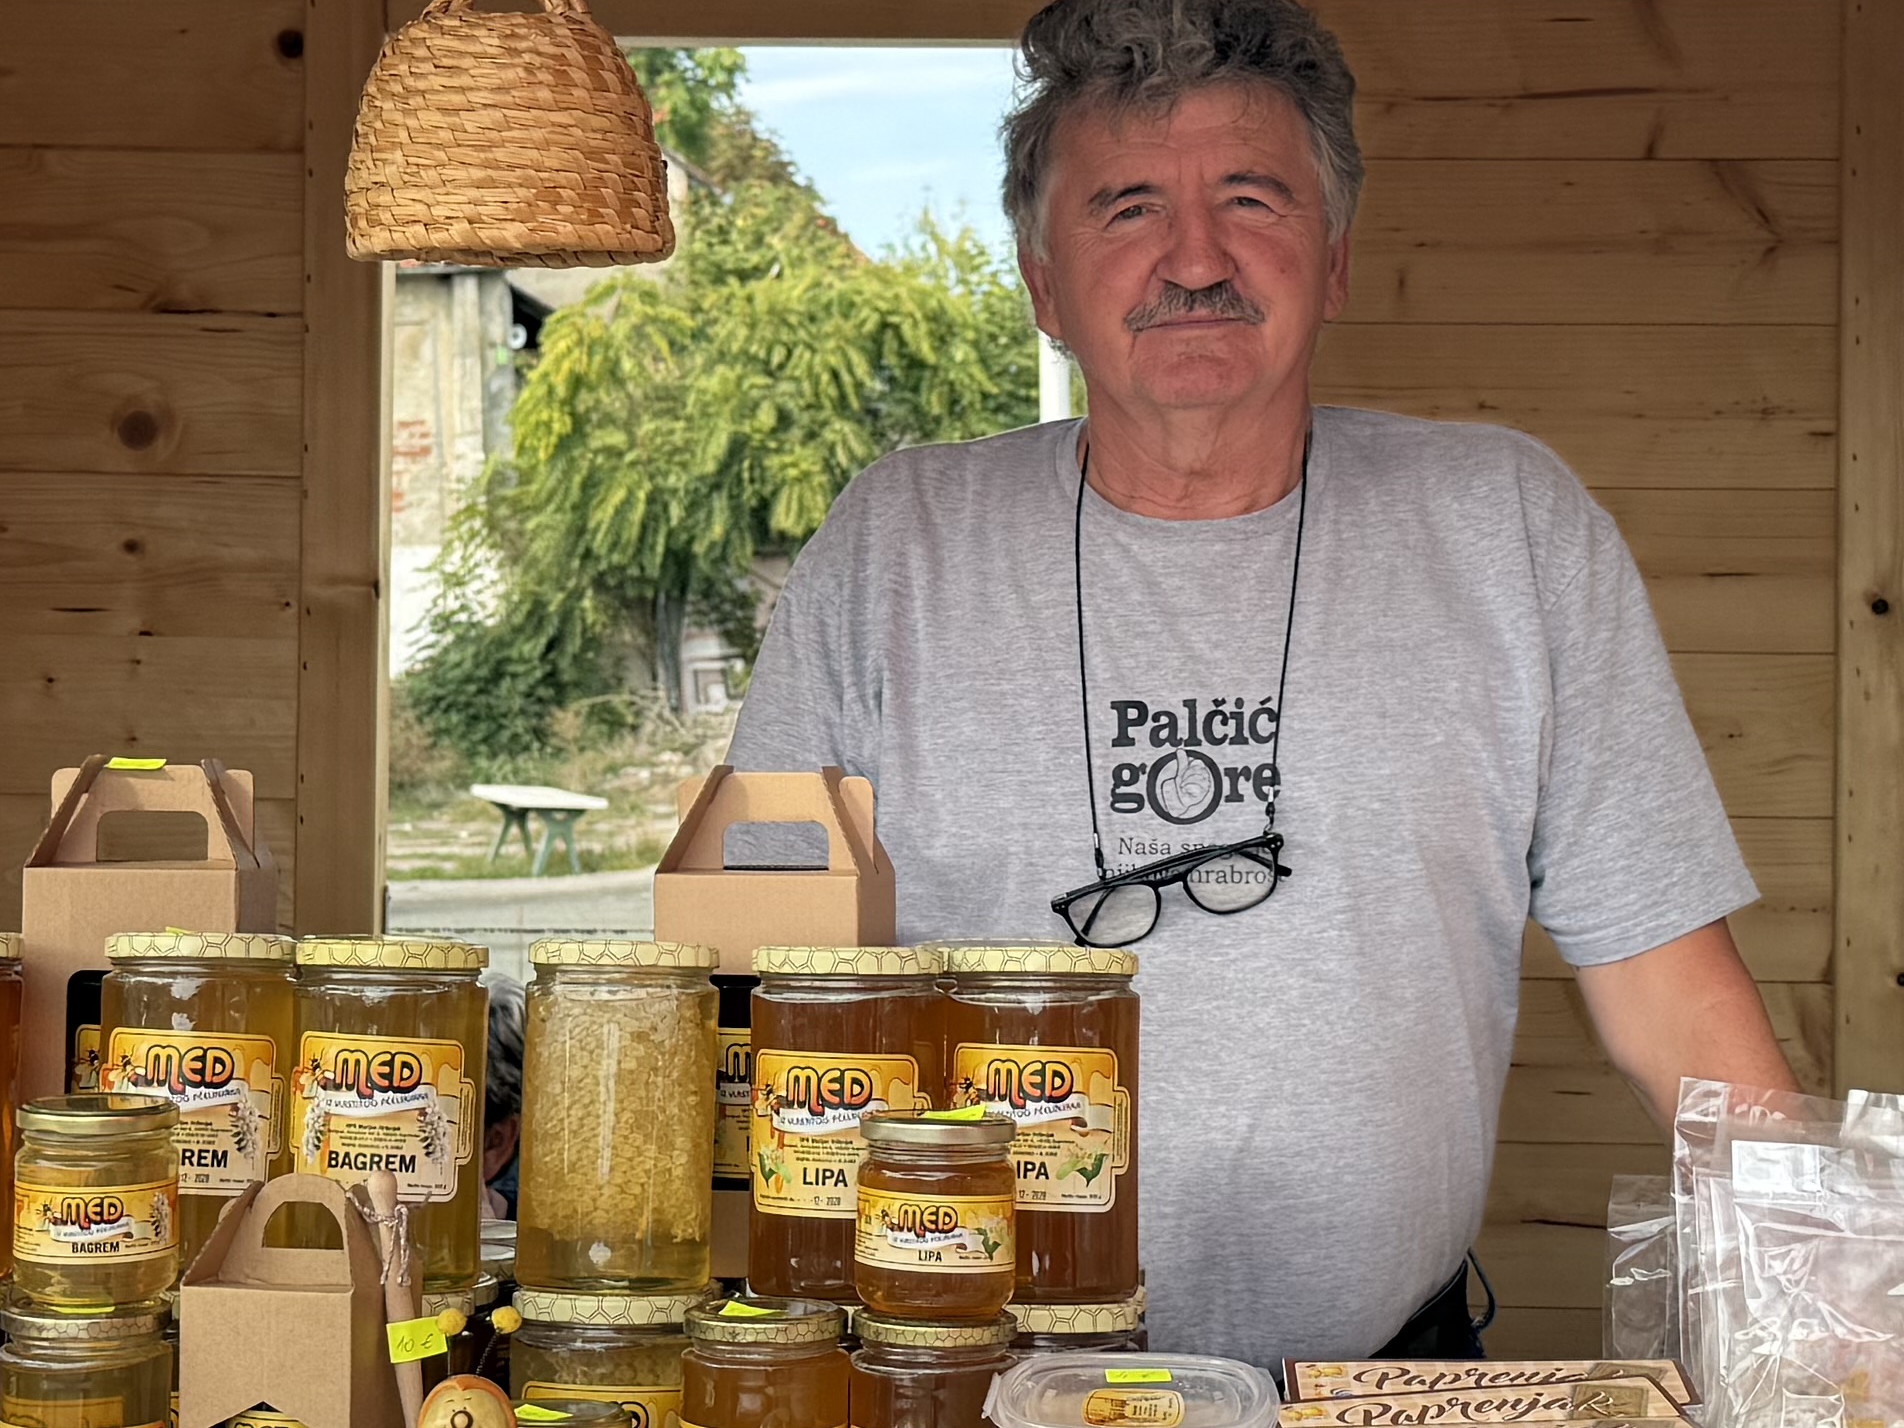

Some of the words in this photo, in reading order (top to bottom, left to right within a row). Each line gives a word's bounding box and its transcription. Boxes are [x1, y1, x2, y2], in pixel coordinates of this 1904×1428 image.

[1110, 695, 1279, 748] Palčić
[1117, 837, 1172, 856] Naša
[335, 1050, 423, 1100] MED
[986, 1058, 1074, 1110] MED
[787, 1066, 873, 1117] MED
[327, 1150, 417, 1174] BAGREM
[801, 1167, 848, 1188] LIPA
[60, 1195, 124, 1229] MED
[898, 1203, 959, 1238] MED
[71, 1241, 120, 1254] BAGREM
[917, 1249, 943, 1263] LIPA
[396, 1335, 415, 1353] 10
